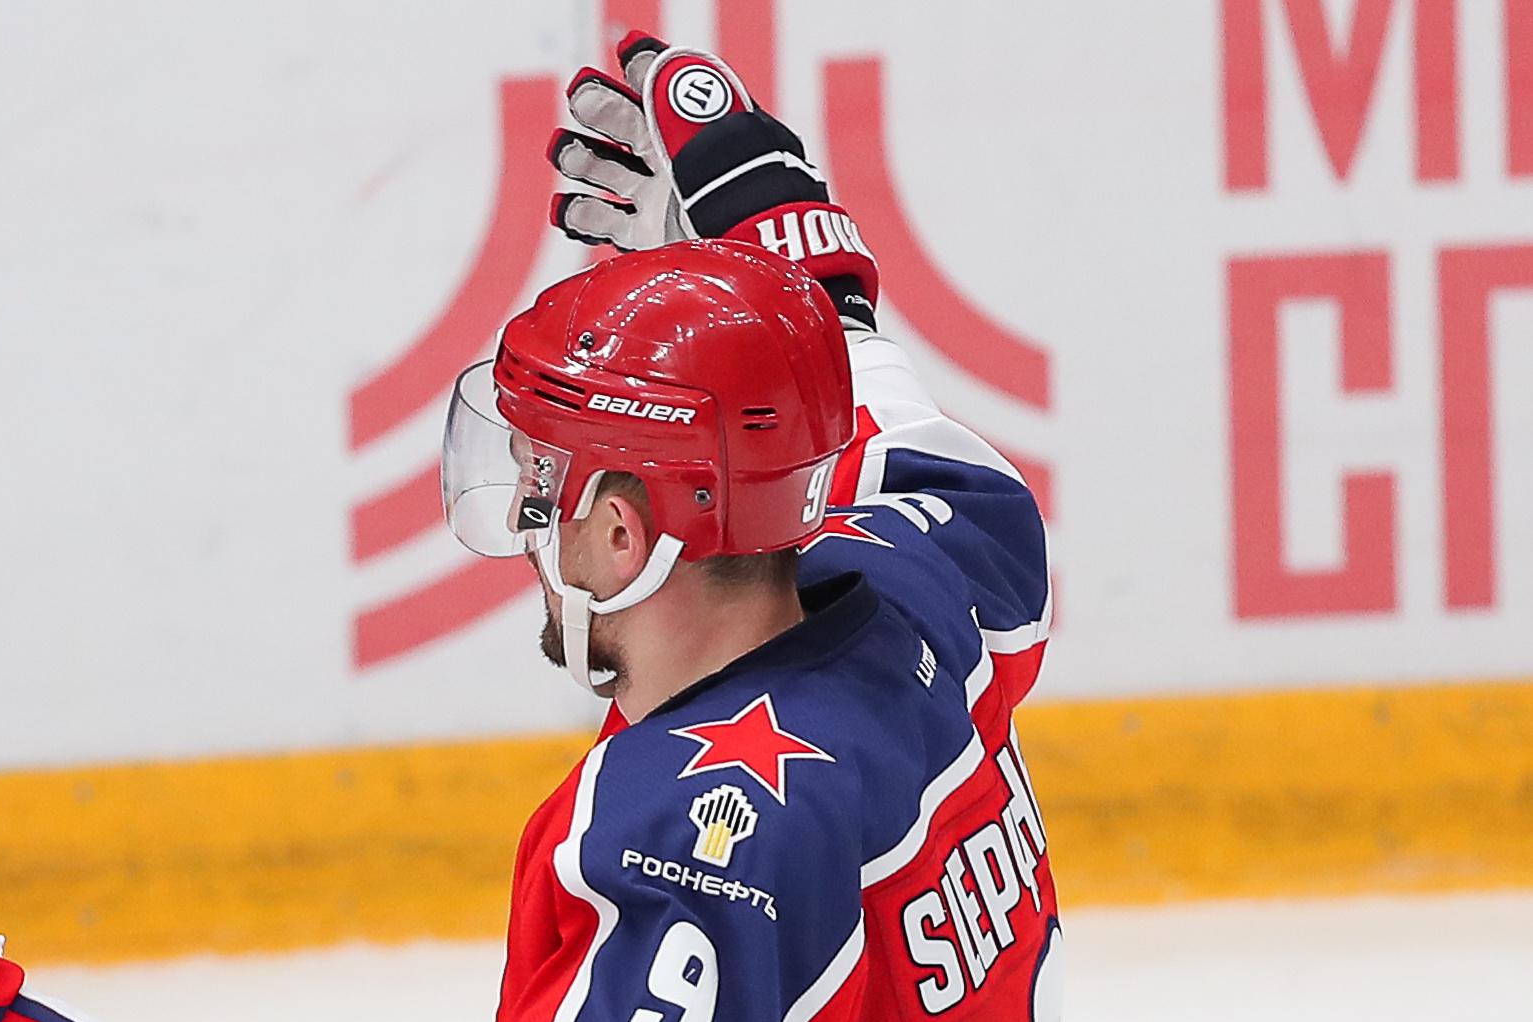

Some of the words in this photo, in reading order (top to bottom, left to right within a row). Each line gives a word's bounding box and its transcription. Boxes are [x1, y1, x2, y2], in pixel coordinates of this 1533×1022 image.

[587, 393, 696, 425] BAUER
[802, 463, 829, 524] 9
[621, 849, 778, 921] РОСНЕФТЬ
